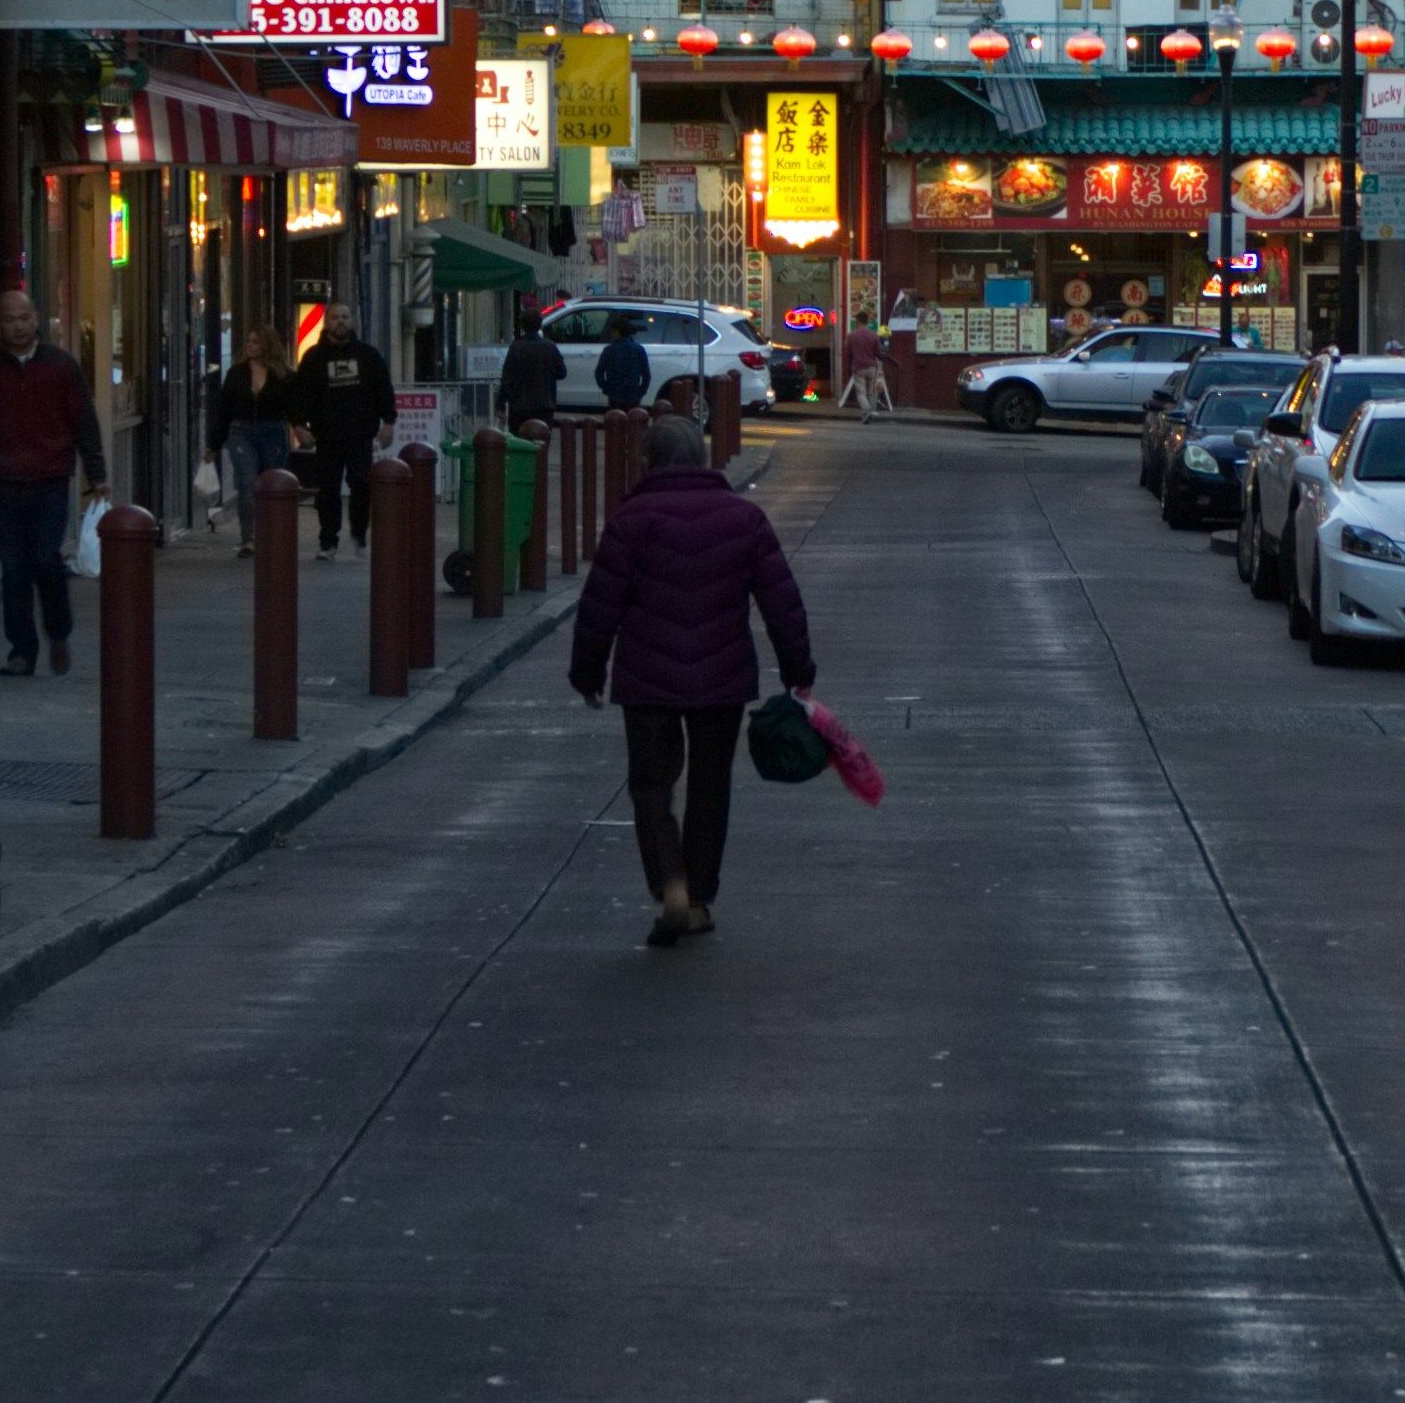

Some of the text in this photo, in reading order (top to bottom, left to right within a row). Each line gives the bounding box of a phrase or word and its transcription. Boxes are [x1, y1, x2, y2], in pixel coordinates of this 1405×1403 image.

[370, 89, 427, 101] UTOPIA Cafe
[1371, 85, 1401, 108] Lucky
[376, 138, 472, 154] 139 WAVERLY PLACE
[500, 146, 540, 161] SALON
[776, 158, 826, 170] Kam Lok
[772, 172, 831, 184] Restaurant
[1079, 206, 1146, 220] HUNAN
[785, 308, 824, 327] OPEN
